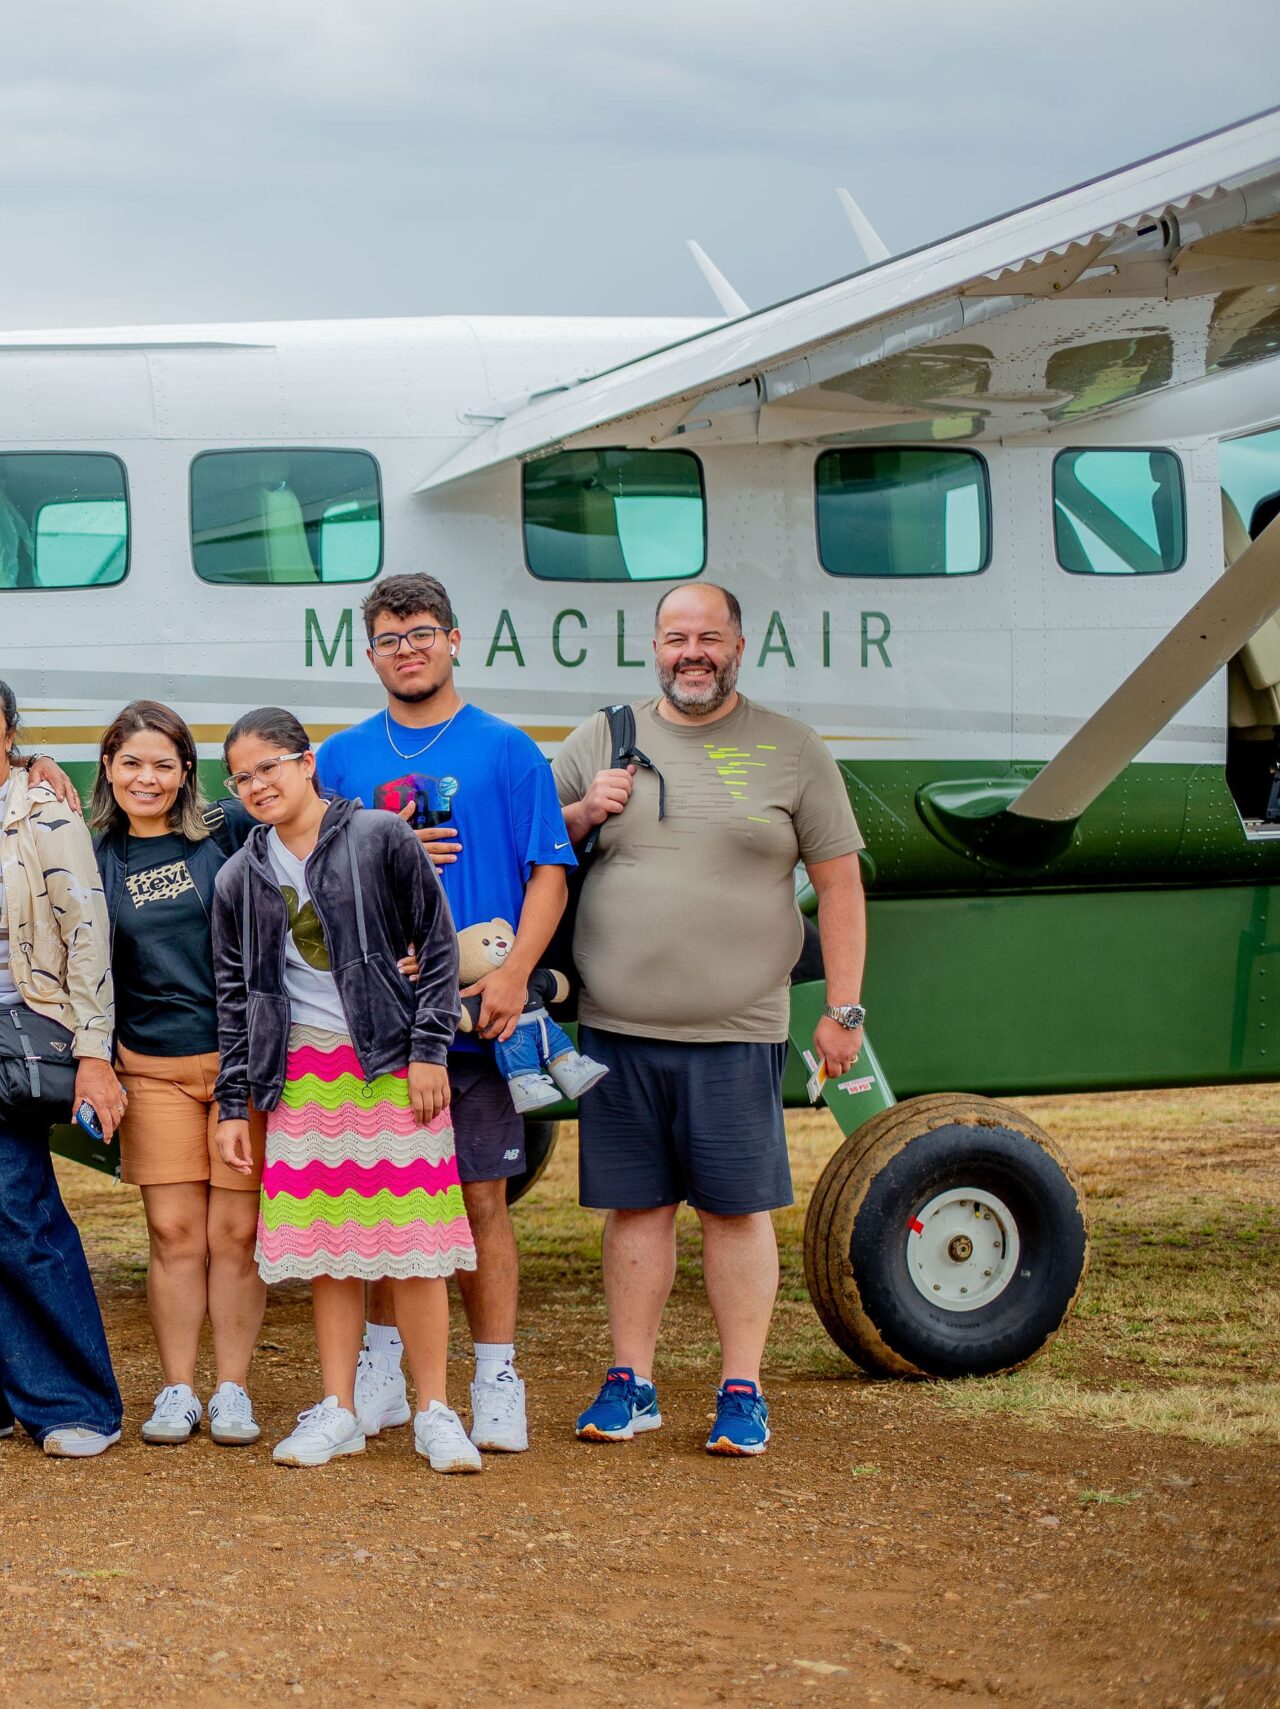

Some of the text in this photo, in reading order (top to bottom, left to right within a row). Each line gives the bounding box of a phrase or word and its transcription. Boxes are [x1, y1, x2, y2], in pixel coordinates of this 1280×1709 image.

[304, 607, 895, 669] MACL AIR
[136, 865, 188, 896] Levi
